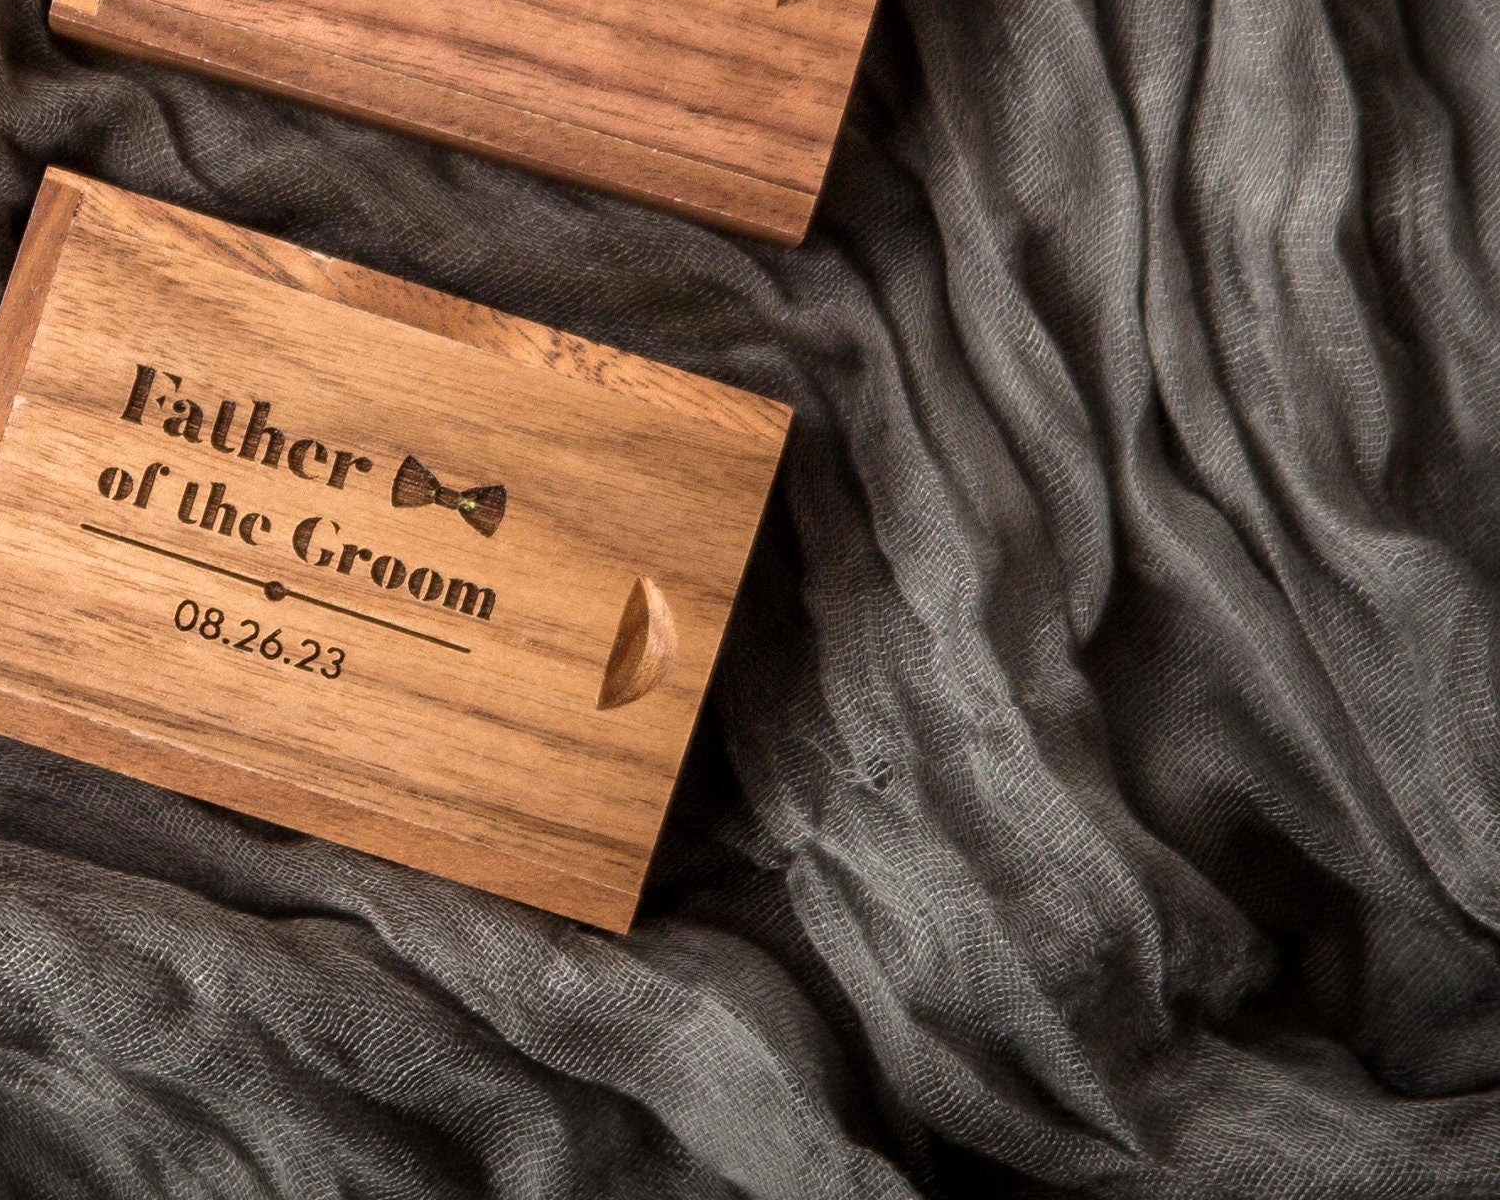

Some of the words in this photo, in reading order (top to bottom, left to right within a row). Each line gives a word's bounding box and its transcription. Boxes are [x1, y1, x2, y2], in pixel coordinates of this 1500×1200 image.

[120, 363, 374, 491] Father
[97, 461, 171, 510] of
[177, 481, 272, 546] the
[292, 516, 498, 622] Groom
[173, 599, 347, 680] 08.26.23
